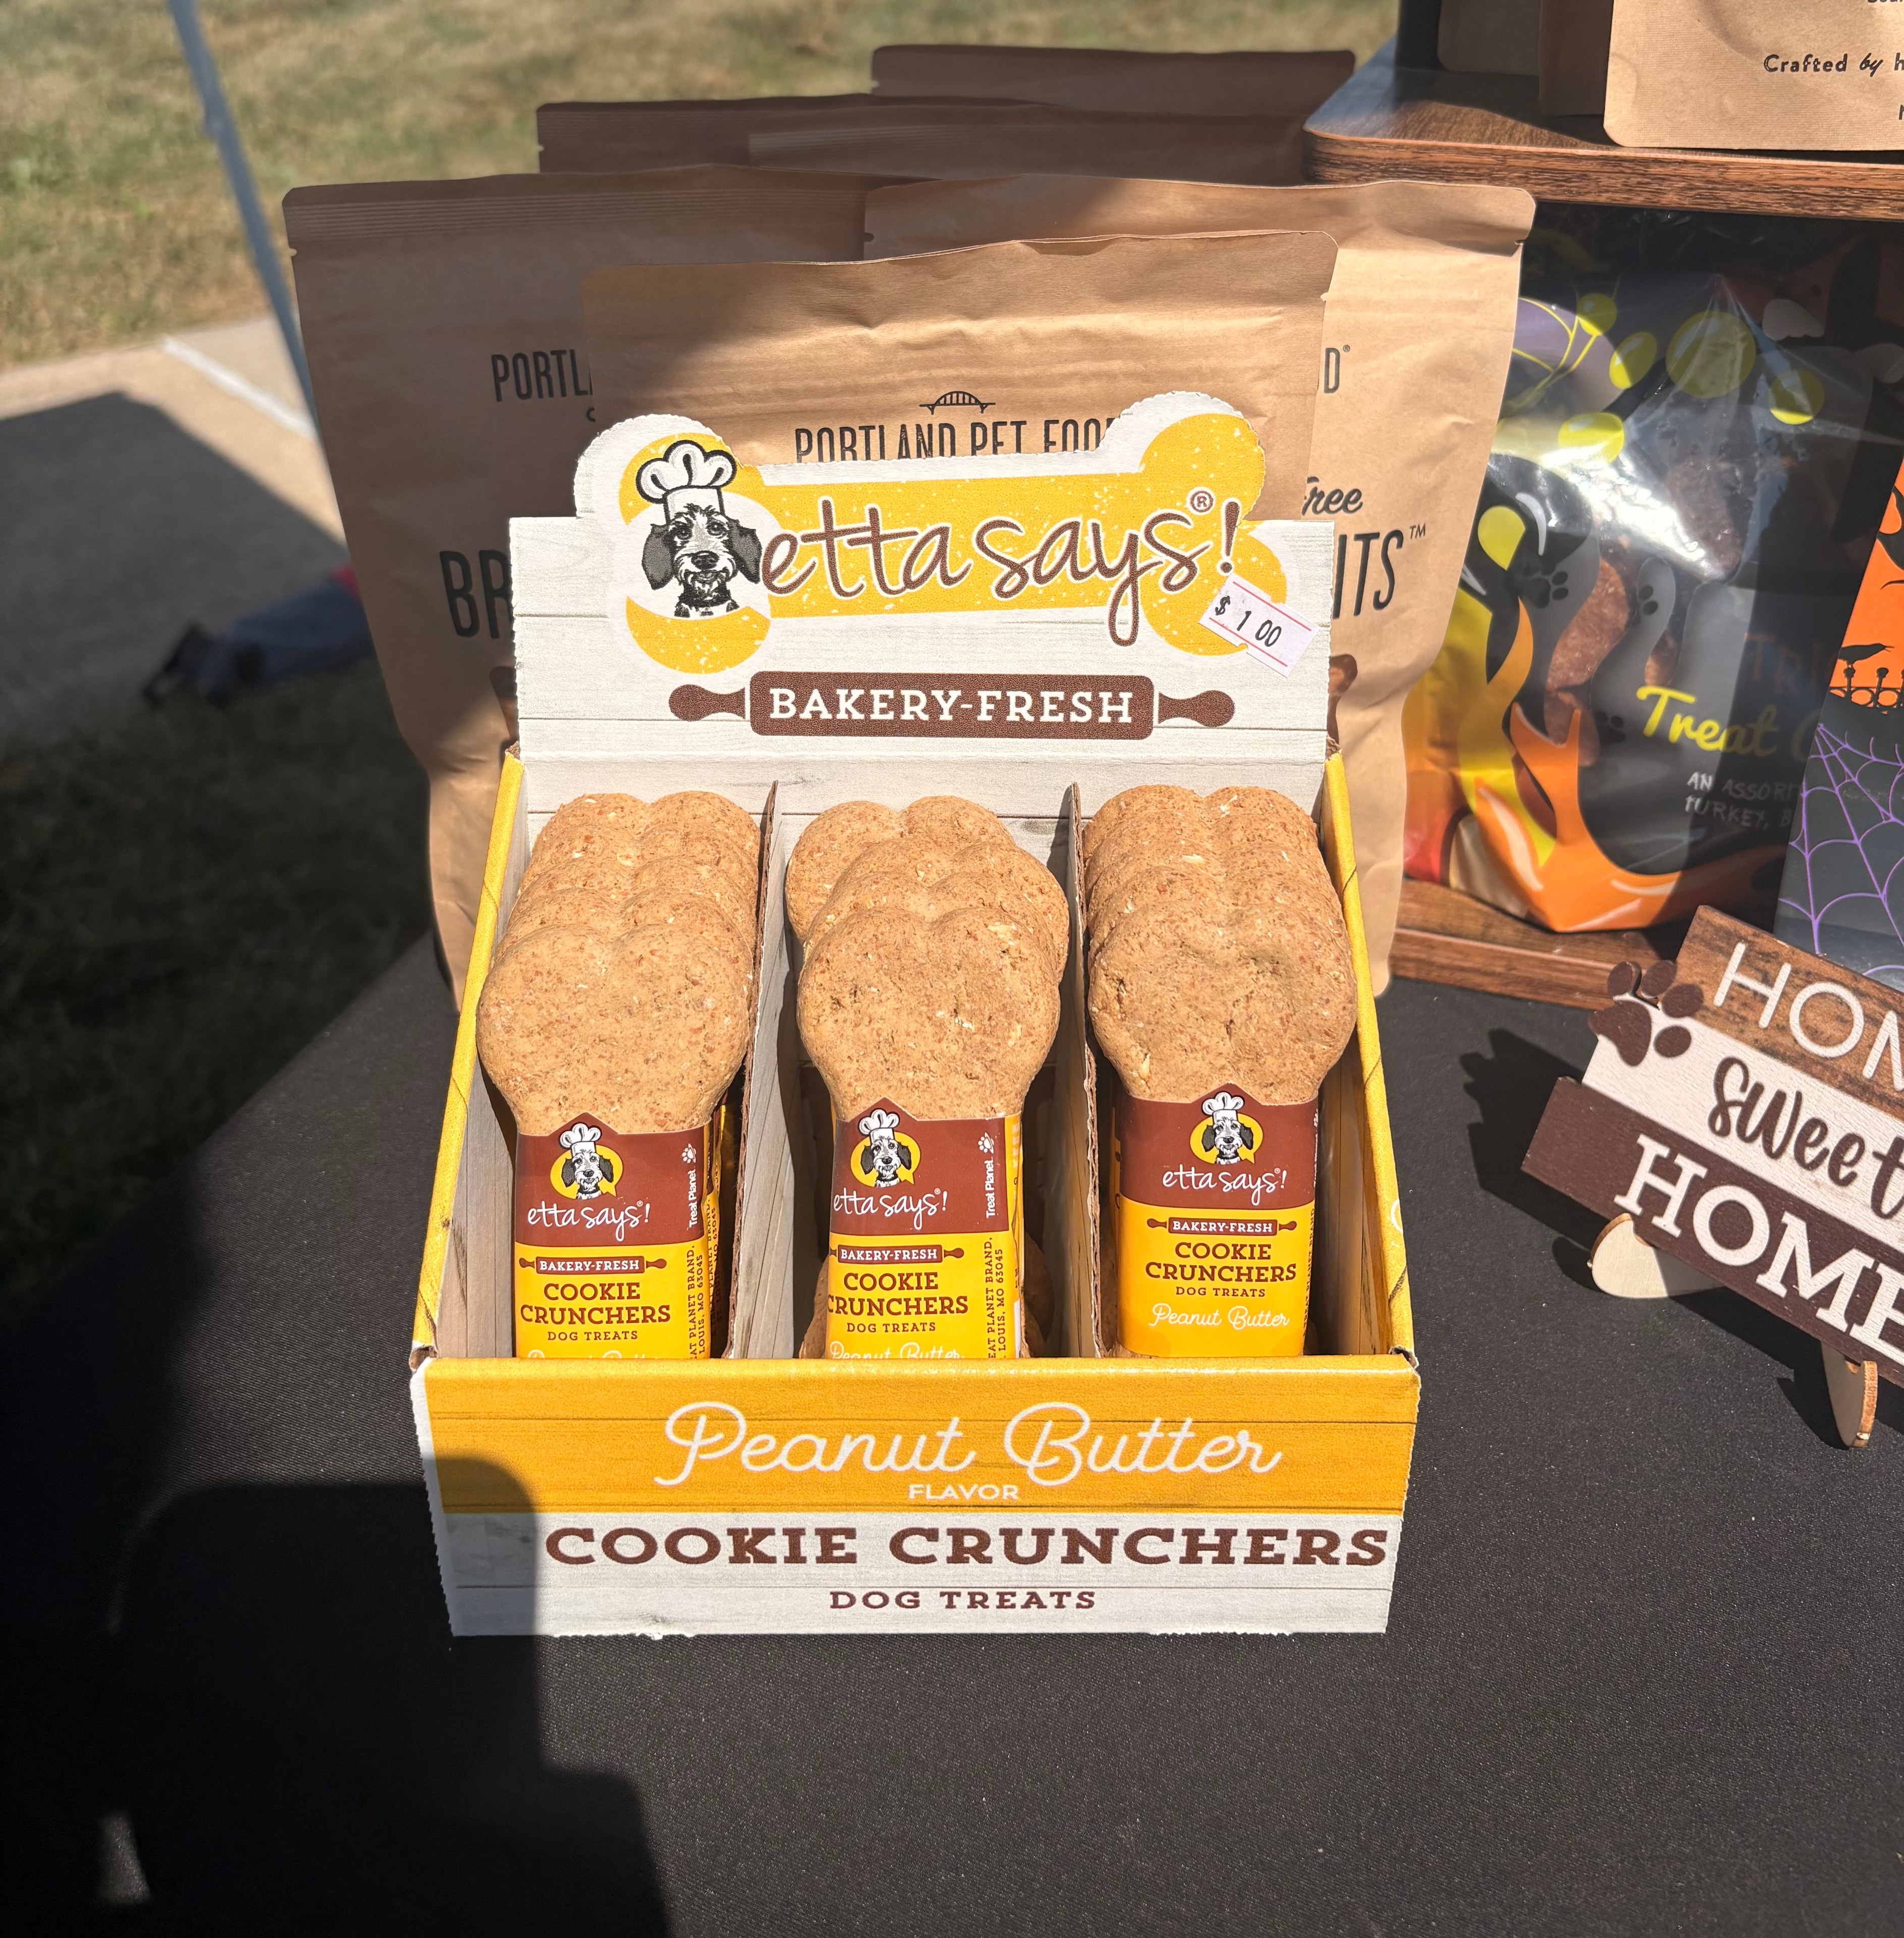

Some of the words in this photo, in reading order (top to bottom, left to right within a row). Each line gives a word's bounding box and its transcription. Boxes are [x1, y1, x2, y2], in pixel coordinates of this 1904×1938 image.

[1764, 53, 1848, 72] Crafted
[1860, 52, 1884, 77] by
[491, 349, 593, 402] PORTL
[795, 424, 956, 463] PORTLAND
[971, 421, 1027, 456] PET
[1043, 418, 1116, 453] FOO
[761, 500, 972, 597] etta
[769, 688, 1133, 723] BAKERY-FRESH
[1636, 686, 1780, 756] Treat
[1686, 771, 1714, 791] AN
[687, 1169, 697, 1201] Planet
[984, 1159, 994, 1192] Planet
[1161, 1163, 1217, 1190] etta
[527, 1200, 580, 1228] etta
[689, 1201, 698, 1228] Treat
[833, 1187, 880, 1215] etta
[985, 1192, 996, 1219] Treat
[1172, 1220, 1273, 1233] BAKERY-FRESH
[840, 1249, 938, 1261] BAKERY-FRESH
[984, 1237, 993, 1283] BRAND,
[1175, 1242, 1272, 1261] COOKIE
[1614, 1134, 1904, 1366] HOME
[539, 1259, 640, 1271] BAKERY-FRESH
[686, 1245, 695, 1290] BRAND,
[995, 1249, 1003, 1283] 63045
[1145, 1262, 1297, 1283] CRUNCHERS
[543, 1282, 641, 1301] COOKIE
[843, 1271, 939, 1291] COOKIE
[1176, 1286, 1206, 1297] DOG
[1212, 1287, 1266, 1298] TREATS
[697, 1293, 704, 1312] MO
[986, 1287, 995, 1333] PLANET
[996, 1288, 1004, 1307] MO
[520, 1304, 671, 1325] CRUNCHERS
[688, 1295, 697, 1339] PLANET
[847, 1322, 877, 1333] DOG
[882, 1322, 936, 1333] TREATS
[1148, 1303, 1222, 1327] Peanut
[1227, 1305, 1290, 1330] Butter
[547, 1331, 578, 1341] DOG
[584, 1330, 638, 1341] TREATS
[997, 1311, 1006, 1352] LOUIS,
[654, 1401, 977, 1486] Peanut
[1003, 1401, 1283, 1487] Butter
[909, 1483, 1020, 1500] FLAVOR
[545, 1527, 858, 1565] COOKIE
[889, 1526, 1387, 1566] CRUNCHERS
[830, 1590, 921, 1609] DOG
[939, 1590, 1096, 1609] TREATS
